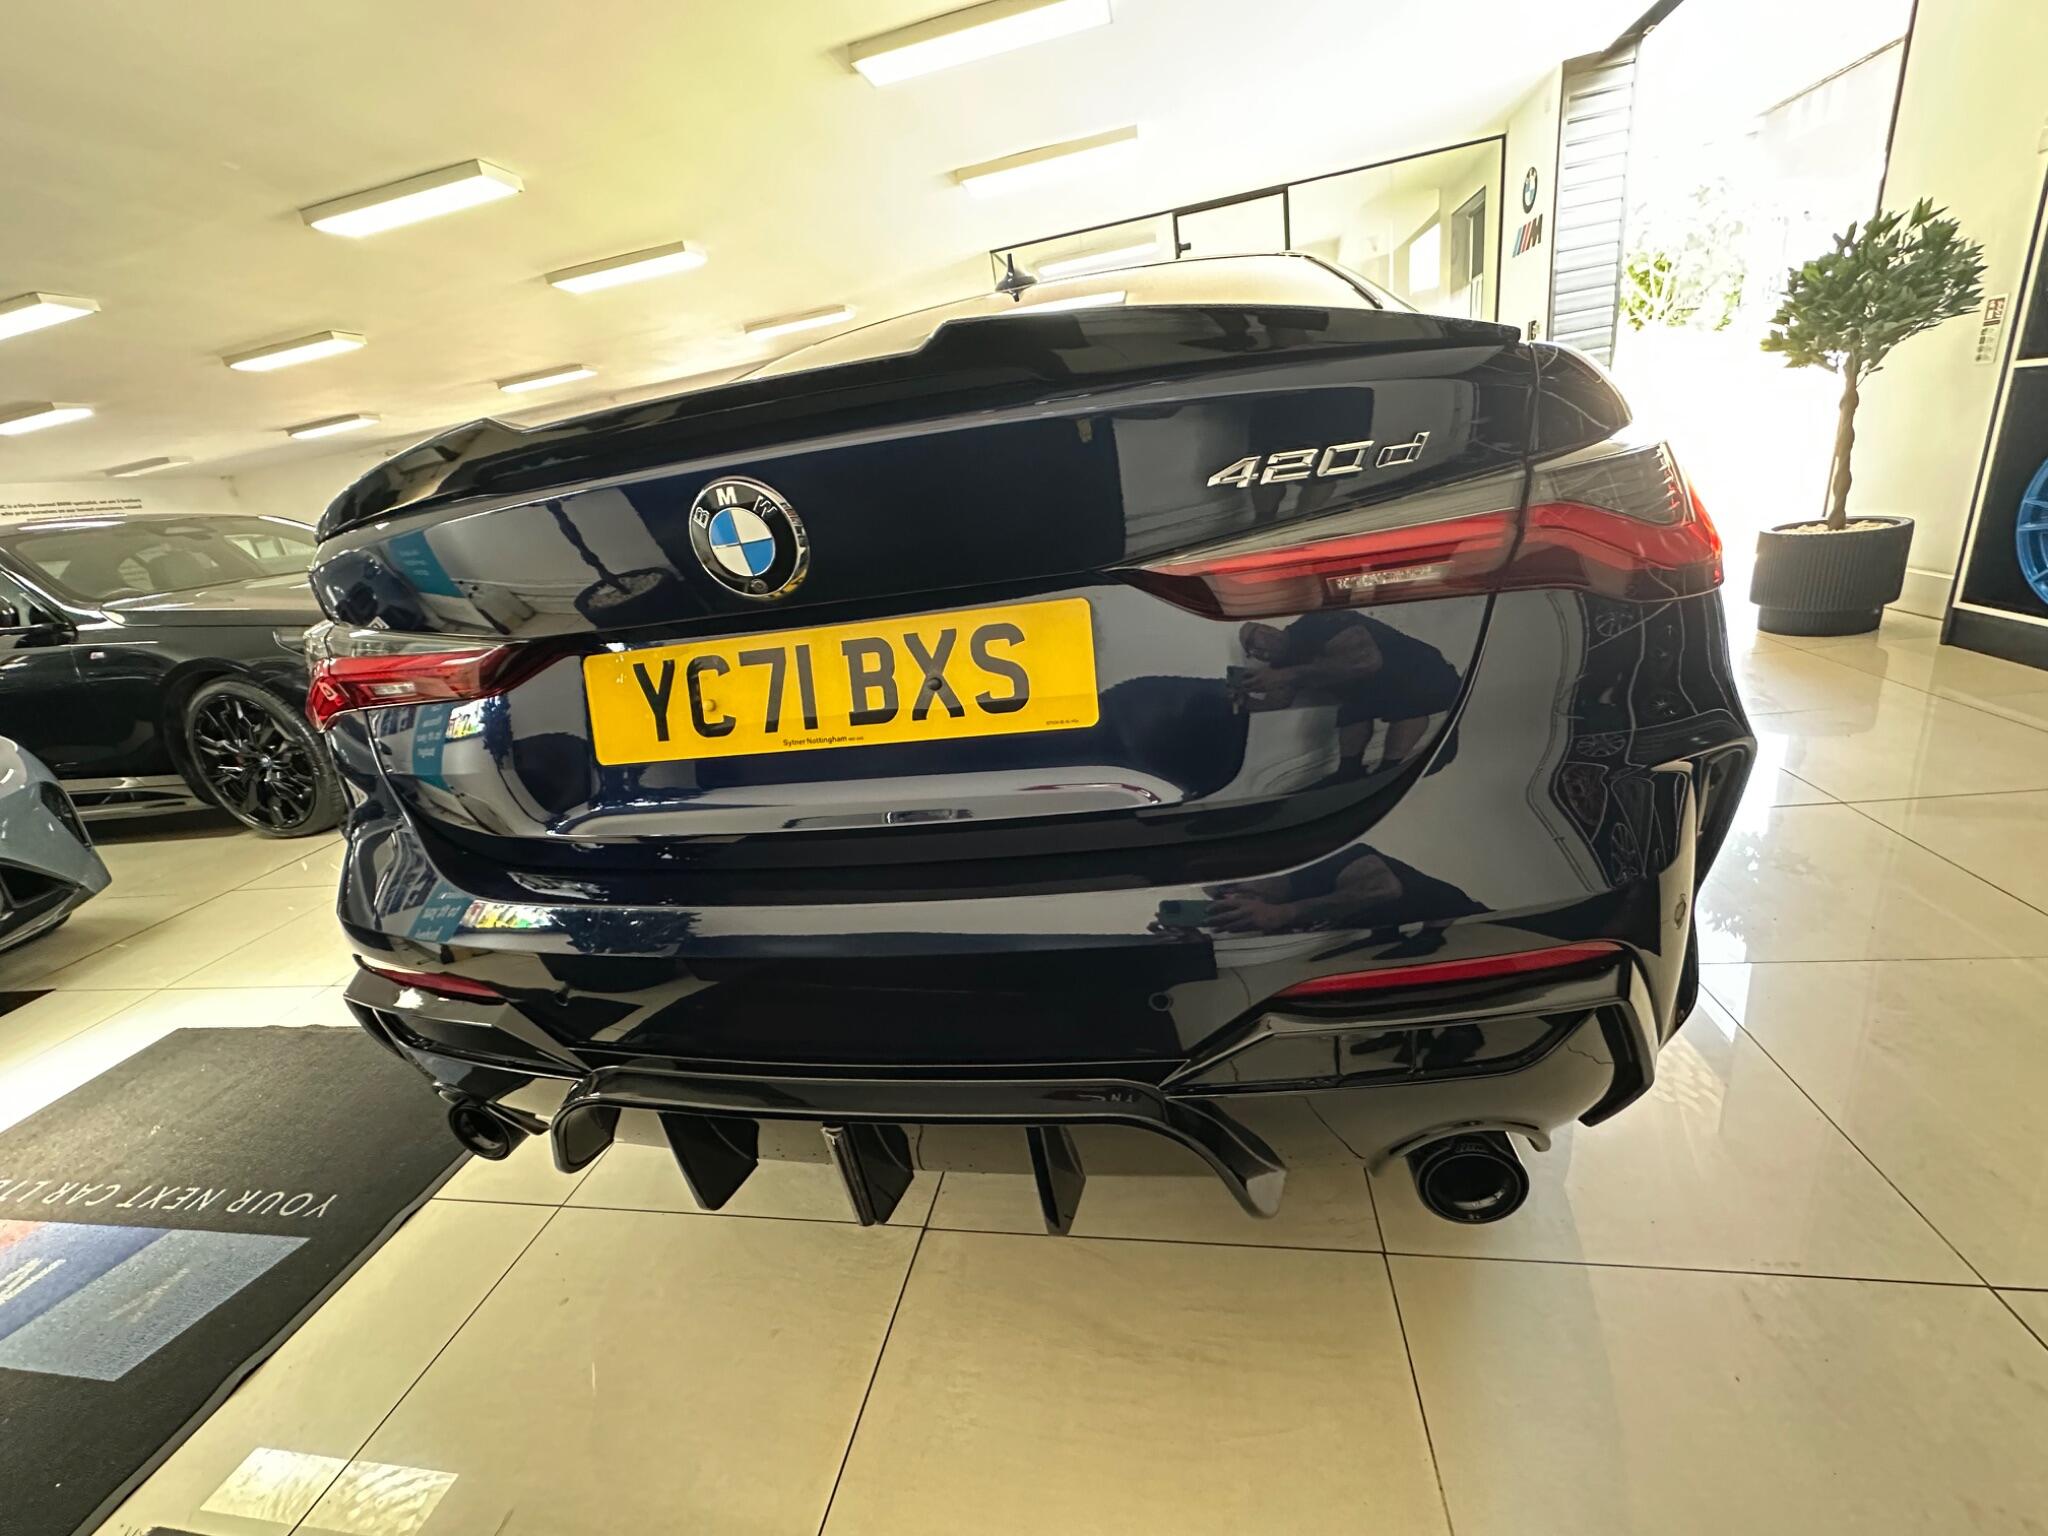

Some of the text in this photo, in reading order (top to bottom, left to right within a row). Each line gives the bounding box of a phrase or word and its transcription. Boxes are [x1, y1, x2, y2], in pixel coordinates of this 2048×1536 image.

[693, 486, 778, 529] BMW
[633, 622, 1030, 742] YC71 BXS
[783, 738, 806, 747] Sytner
[806, 735, 847, 745] Nottingham
[42, 1182, 122, 1207] CAR
[116, 1184, 226, 1212] NEXT
[225, 1190, 338, 1218] YOUR
